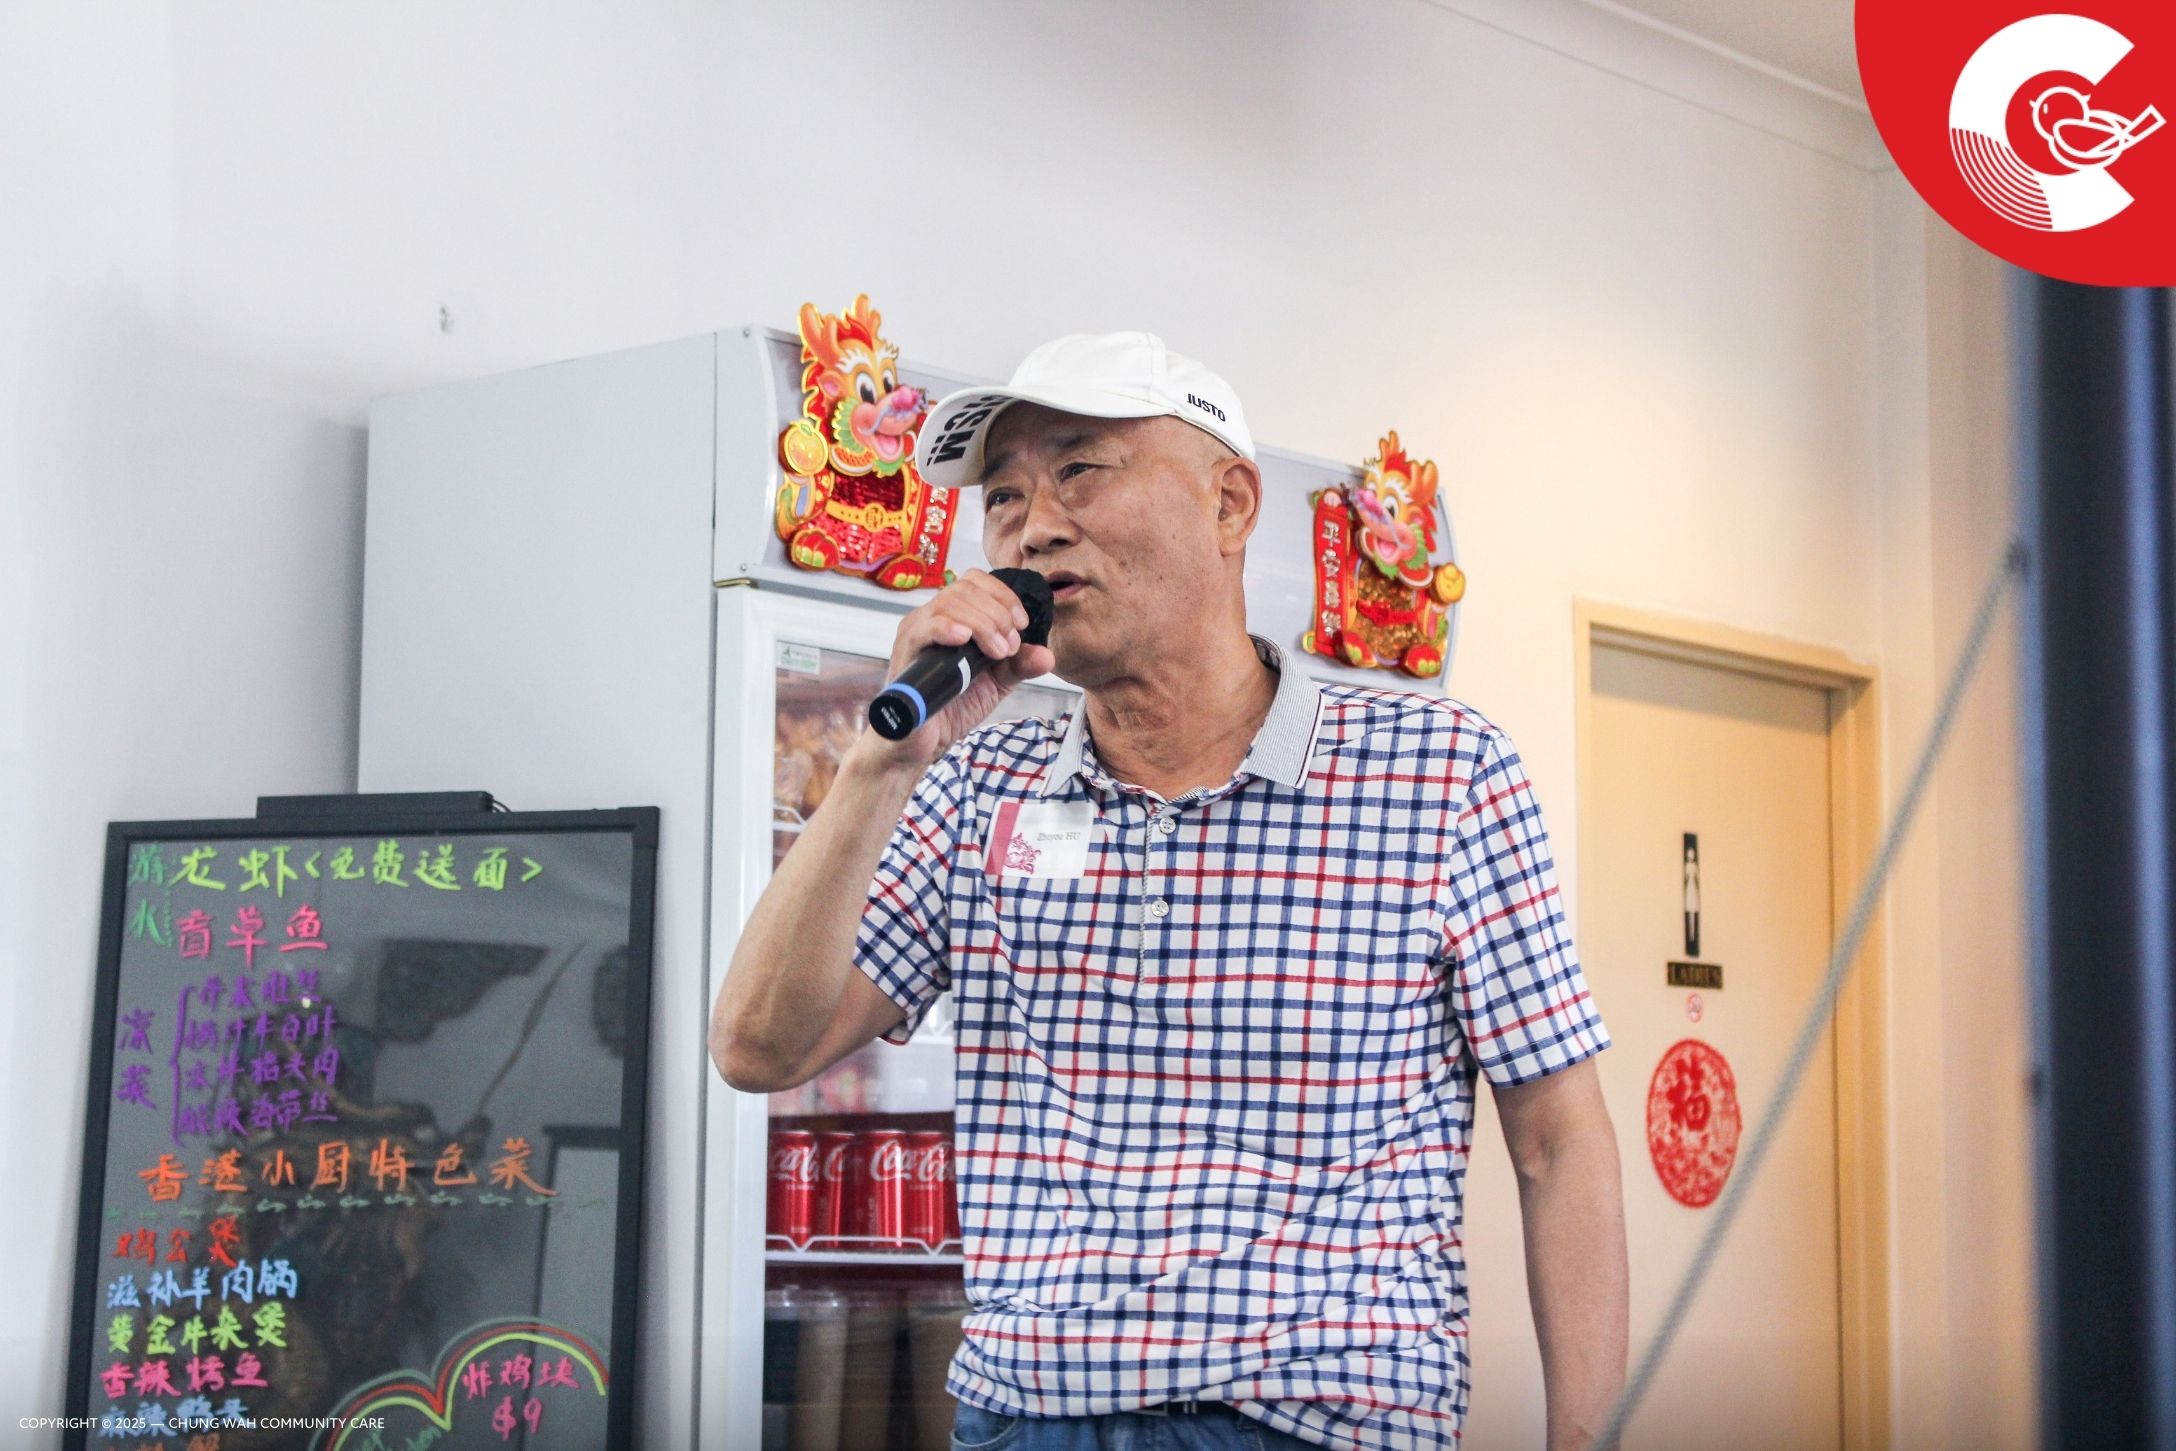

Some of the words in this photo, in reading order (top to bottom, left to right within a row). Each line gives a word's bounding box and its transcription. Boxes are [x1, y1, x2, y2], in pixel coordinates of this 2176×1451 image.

[138, 1137, 558, 1200] 香港小厨特色菜
[462, 1353, 581, 1399] 炸鸡块
[491, 1395, 543, 1440] $9
